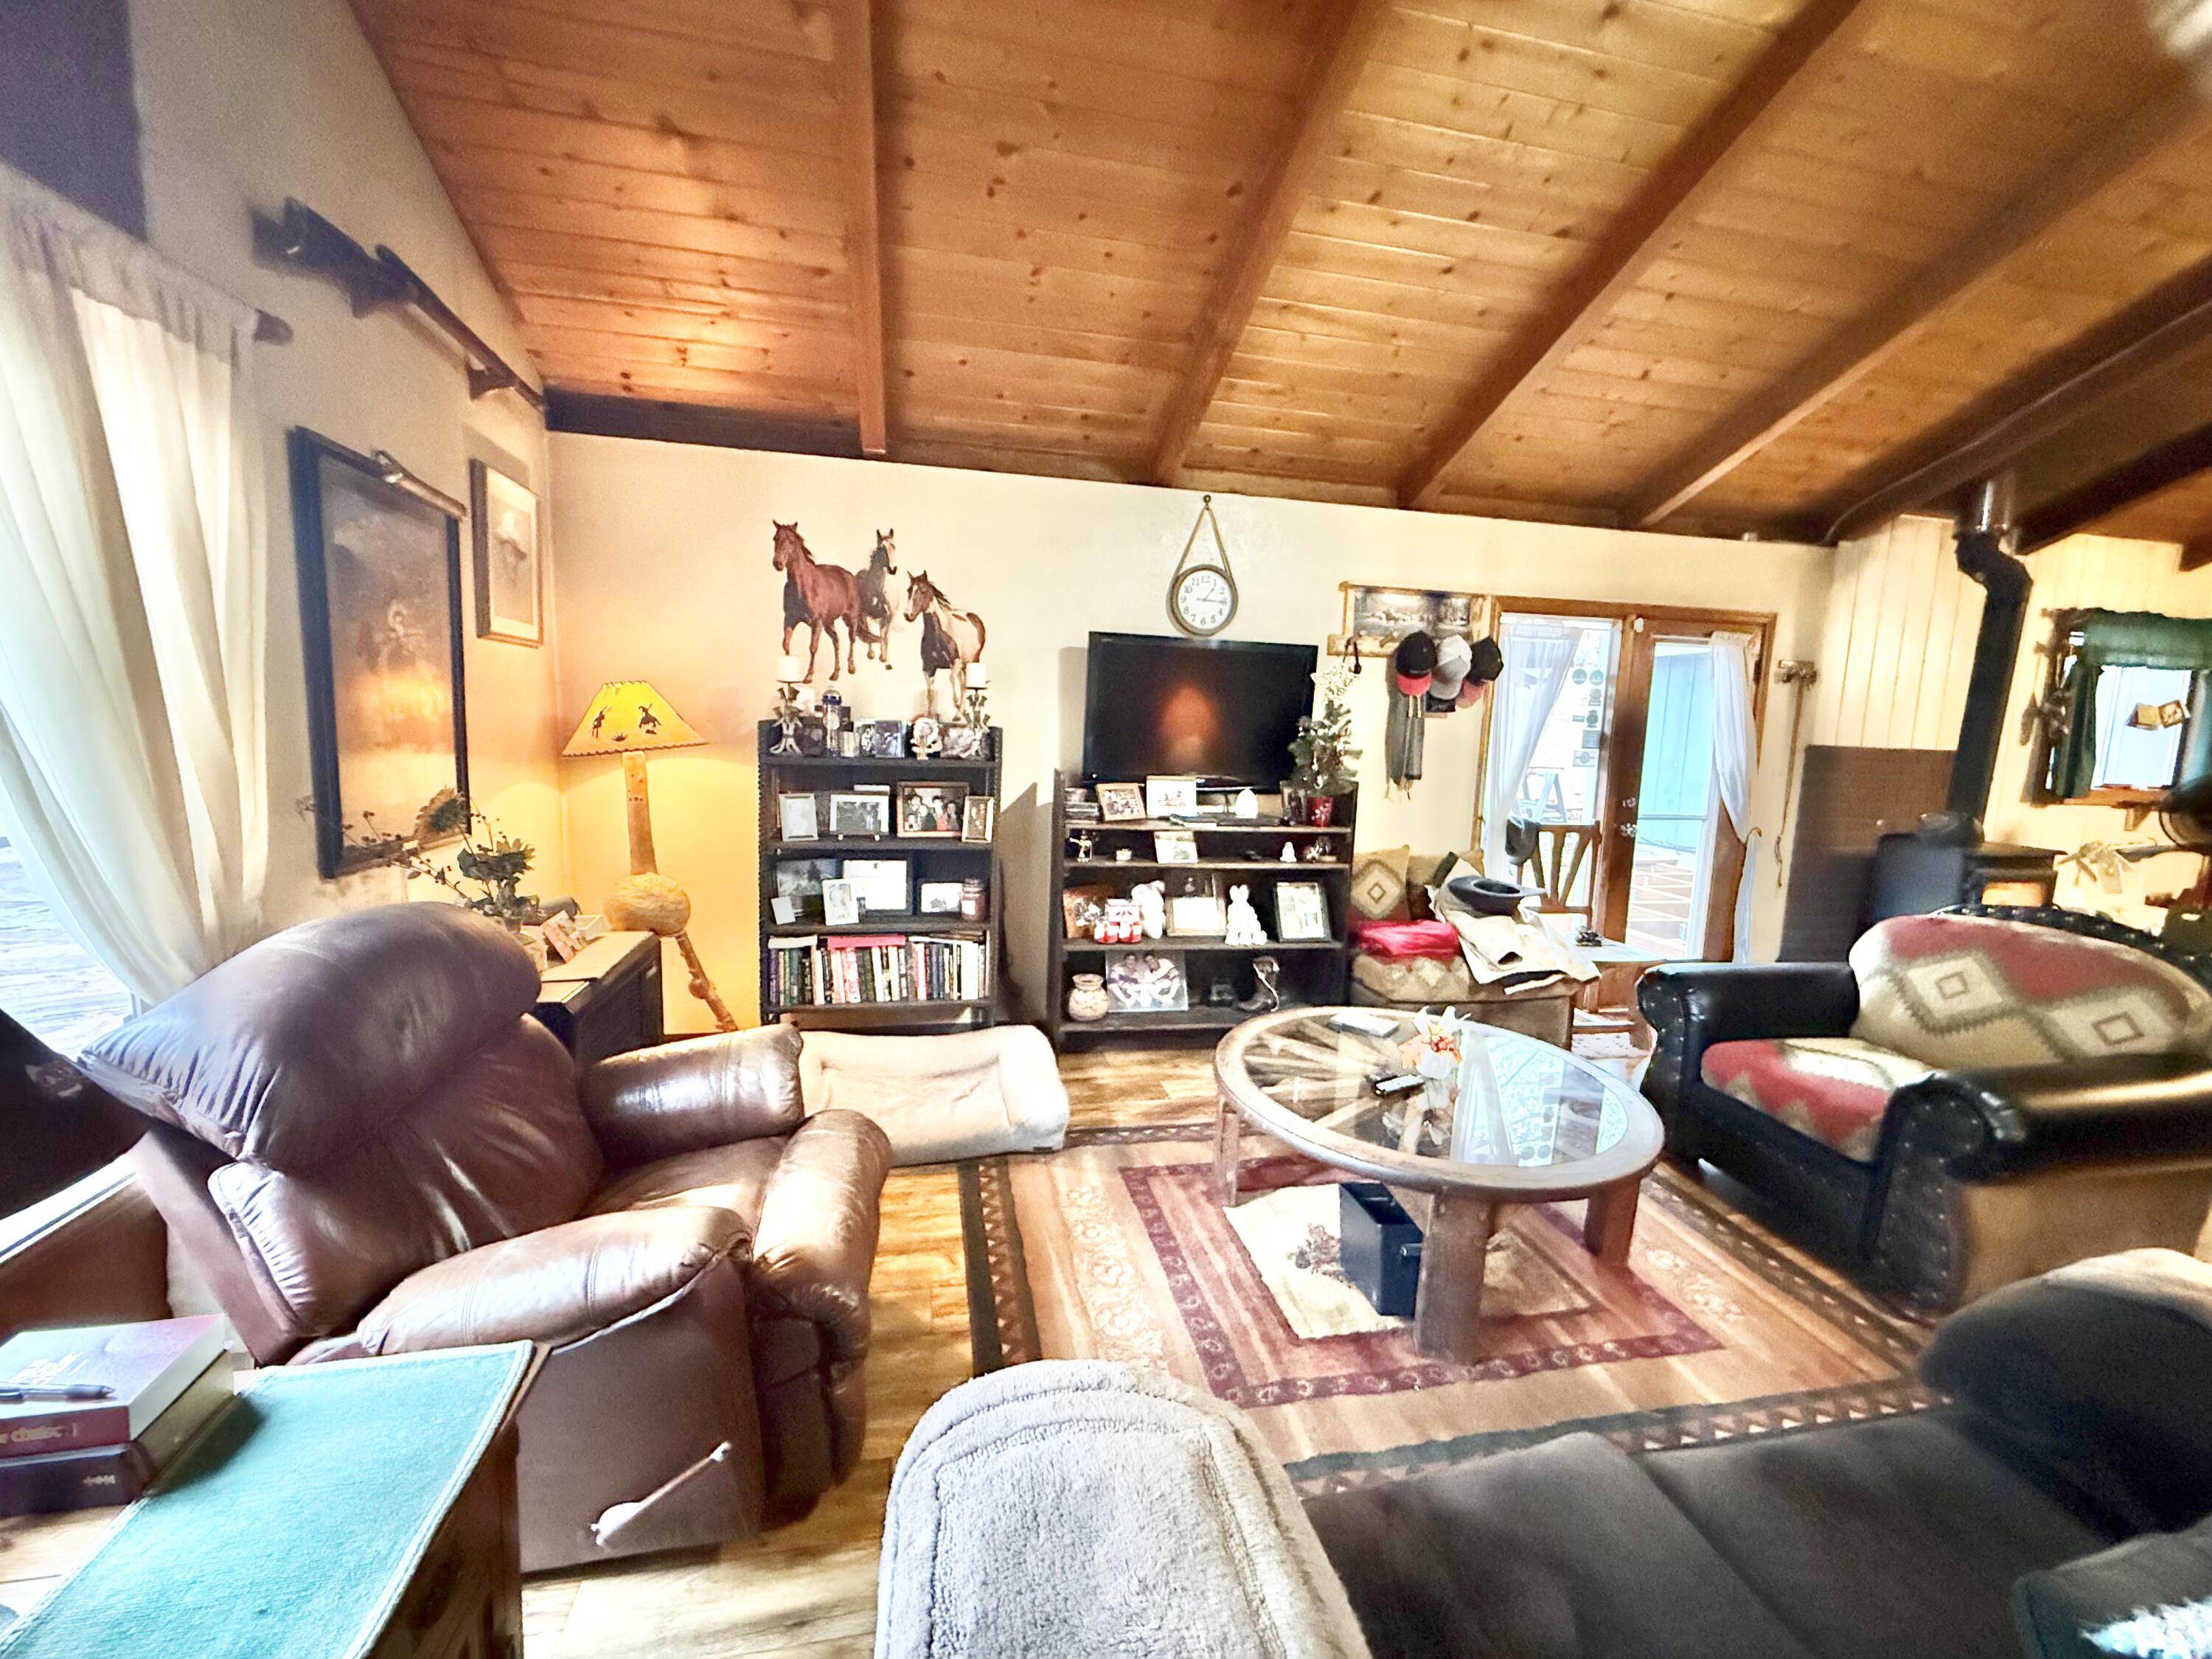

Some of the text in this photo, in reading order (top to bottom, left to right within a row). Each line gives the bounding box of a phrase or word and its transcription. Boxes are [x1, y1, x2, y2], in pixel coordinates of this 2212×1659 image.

[1192, 577, 1200, 586] 11
[1201, 575, 1210, 583] 12
[1184, 585, 1192, 594] 10
[1220, 586, 1225, 594] 2
[1180, 595, 1187, 603] 9
[1183, 605, 1189, 614] 8
[1217, 608, 1223, 616] 4
[1191, 613, 1197, 622] 7
[1200, 617, 1206, 625] 6
[1210, 615, 1216, 624] 5
